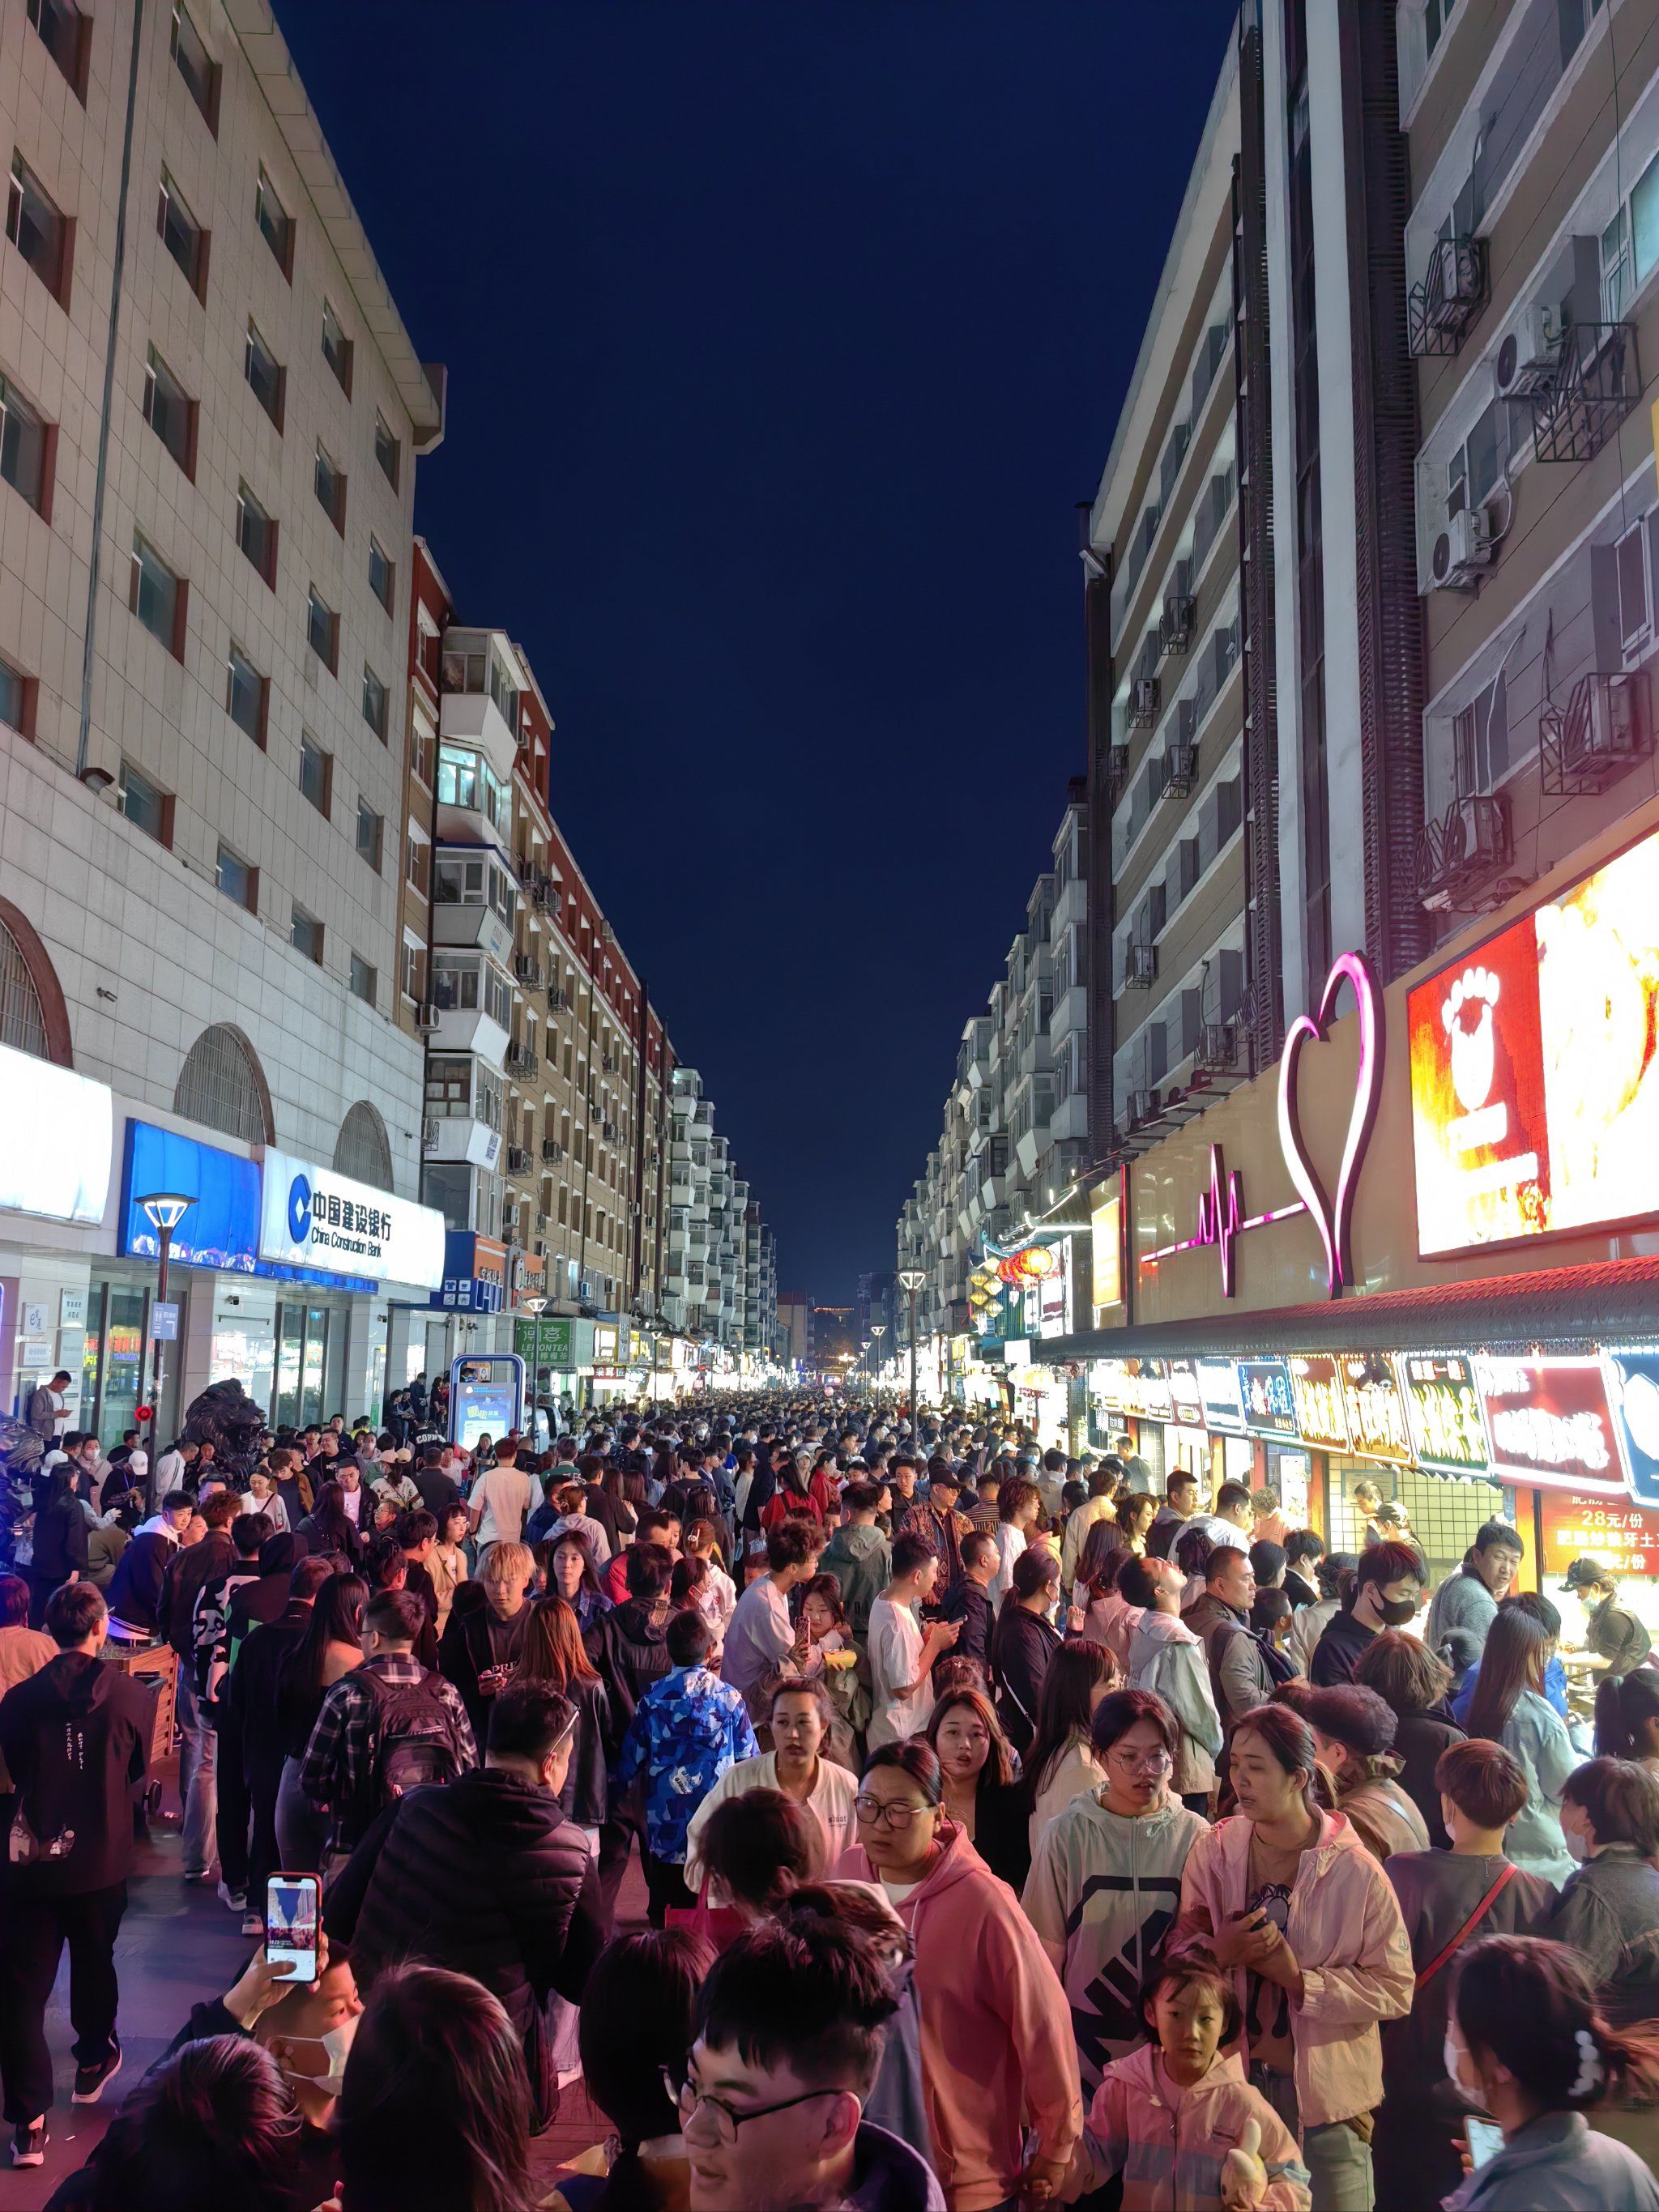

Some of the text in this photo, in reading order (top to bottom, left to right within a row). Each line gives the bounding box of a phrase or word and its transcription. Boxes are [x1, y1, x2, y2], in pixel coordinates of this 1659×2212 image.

[313, 1191, 391, 1242] 中国建设银行
[311, 1225, 382, 1258] China Construction Bank
[1581, 1510, 1644, 1528] 28元/份
